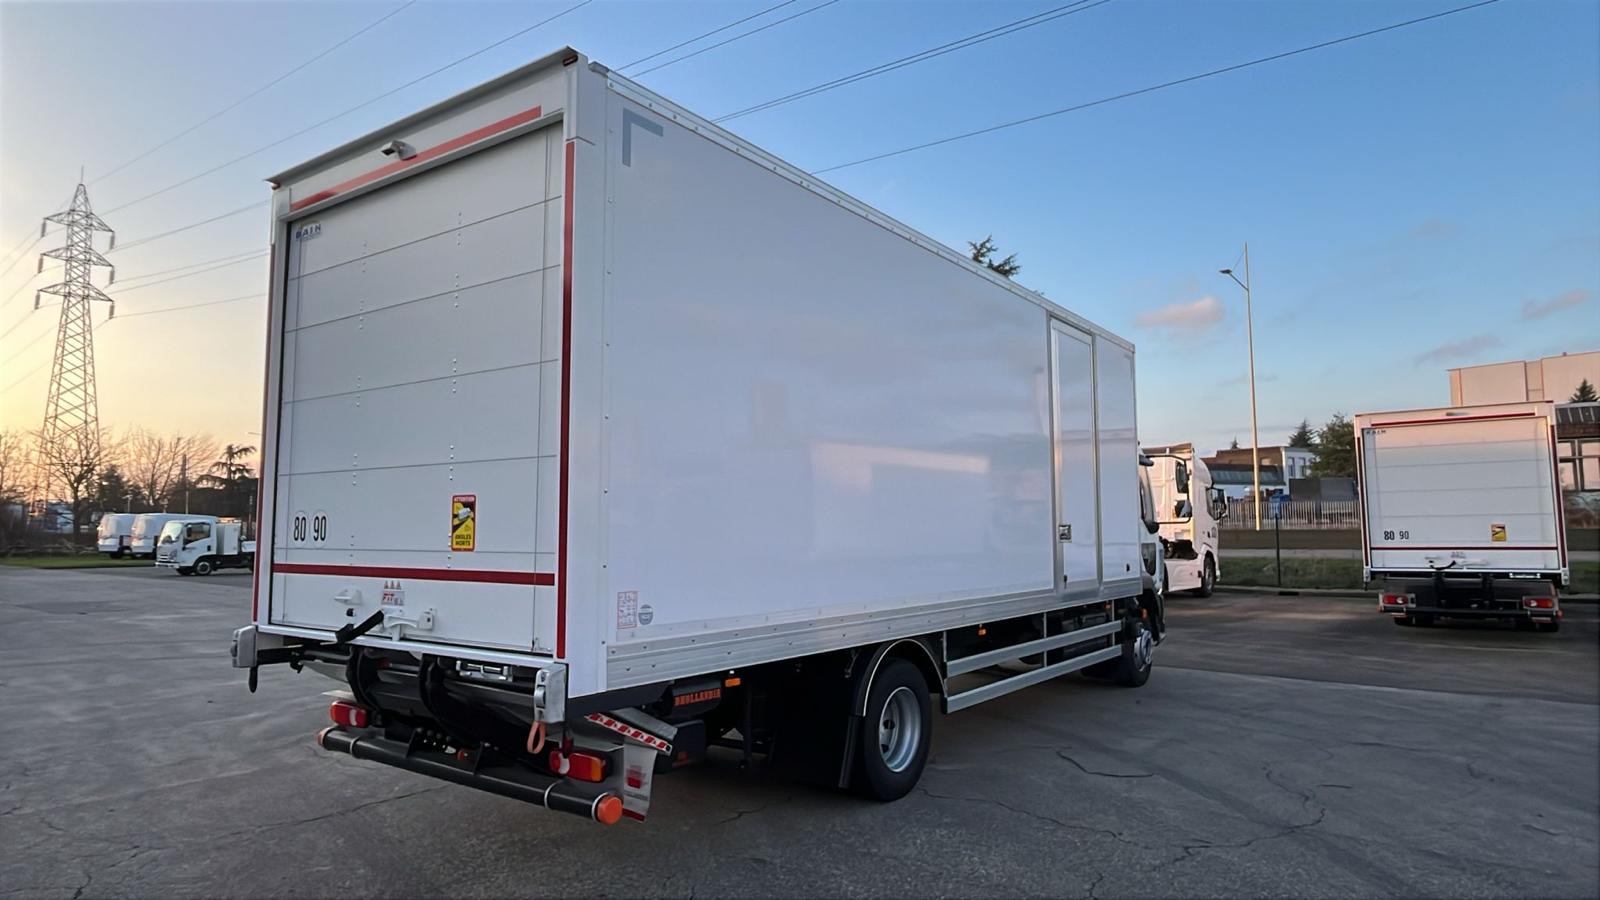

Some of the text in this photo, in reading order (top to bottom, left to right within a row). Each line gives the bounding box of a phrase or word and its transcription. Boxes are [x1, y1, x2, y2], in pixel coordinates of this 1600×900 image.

[293, 515, 327, 542] 80 90
[1383, 530, 1410, 541] 80 90
